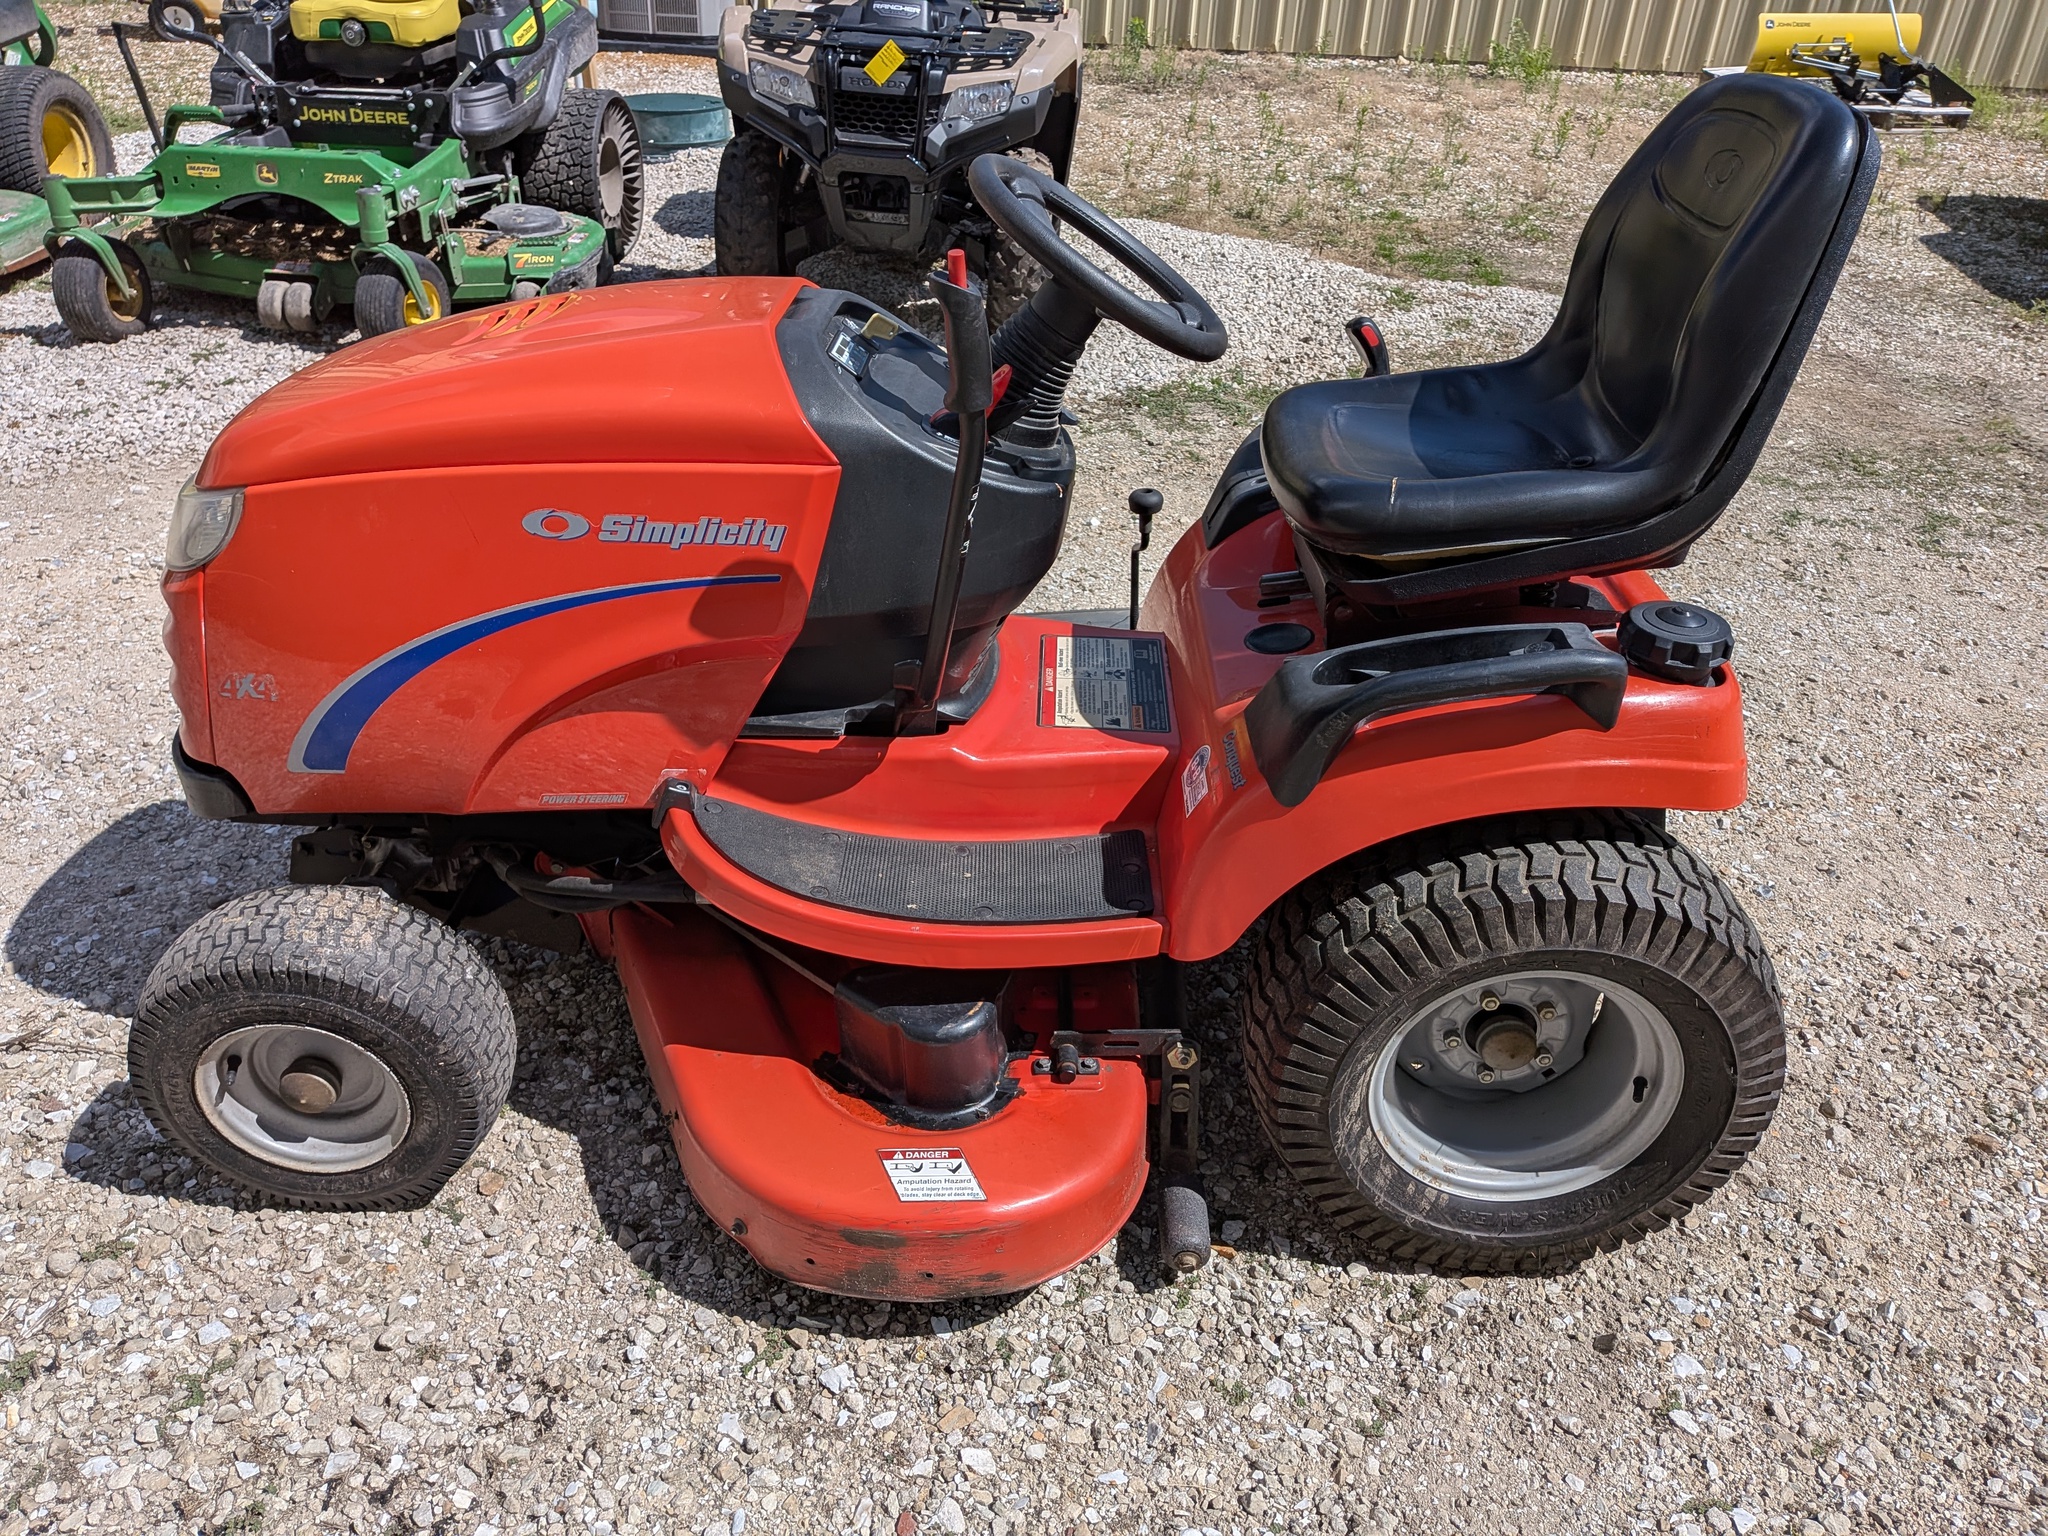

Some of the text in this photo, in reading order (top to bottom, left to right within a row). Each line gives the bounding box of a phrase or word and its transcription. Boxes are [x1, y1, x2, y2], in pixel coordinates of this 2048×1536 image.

[873, 3, 921, 14] RANCHER
[848, 77, 906, 89] HODA
[299, 106, 410, 125] JOHN DEERE
[188, 165, 219, 173] MARTIN
[323, 172, 364, 184] ZTRAK
[597, 514, 788, 552] Simplicity
[1045, 667, 1054, 686] DANGER
[1223, 730, 1246, 790] Conquest
[541, 795, 625, 804] POWER STEERING
[905, 1151, 949, 1159] DANGER
[897, 1178, 942, 1186] Amputation
